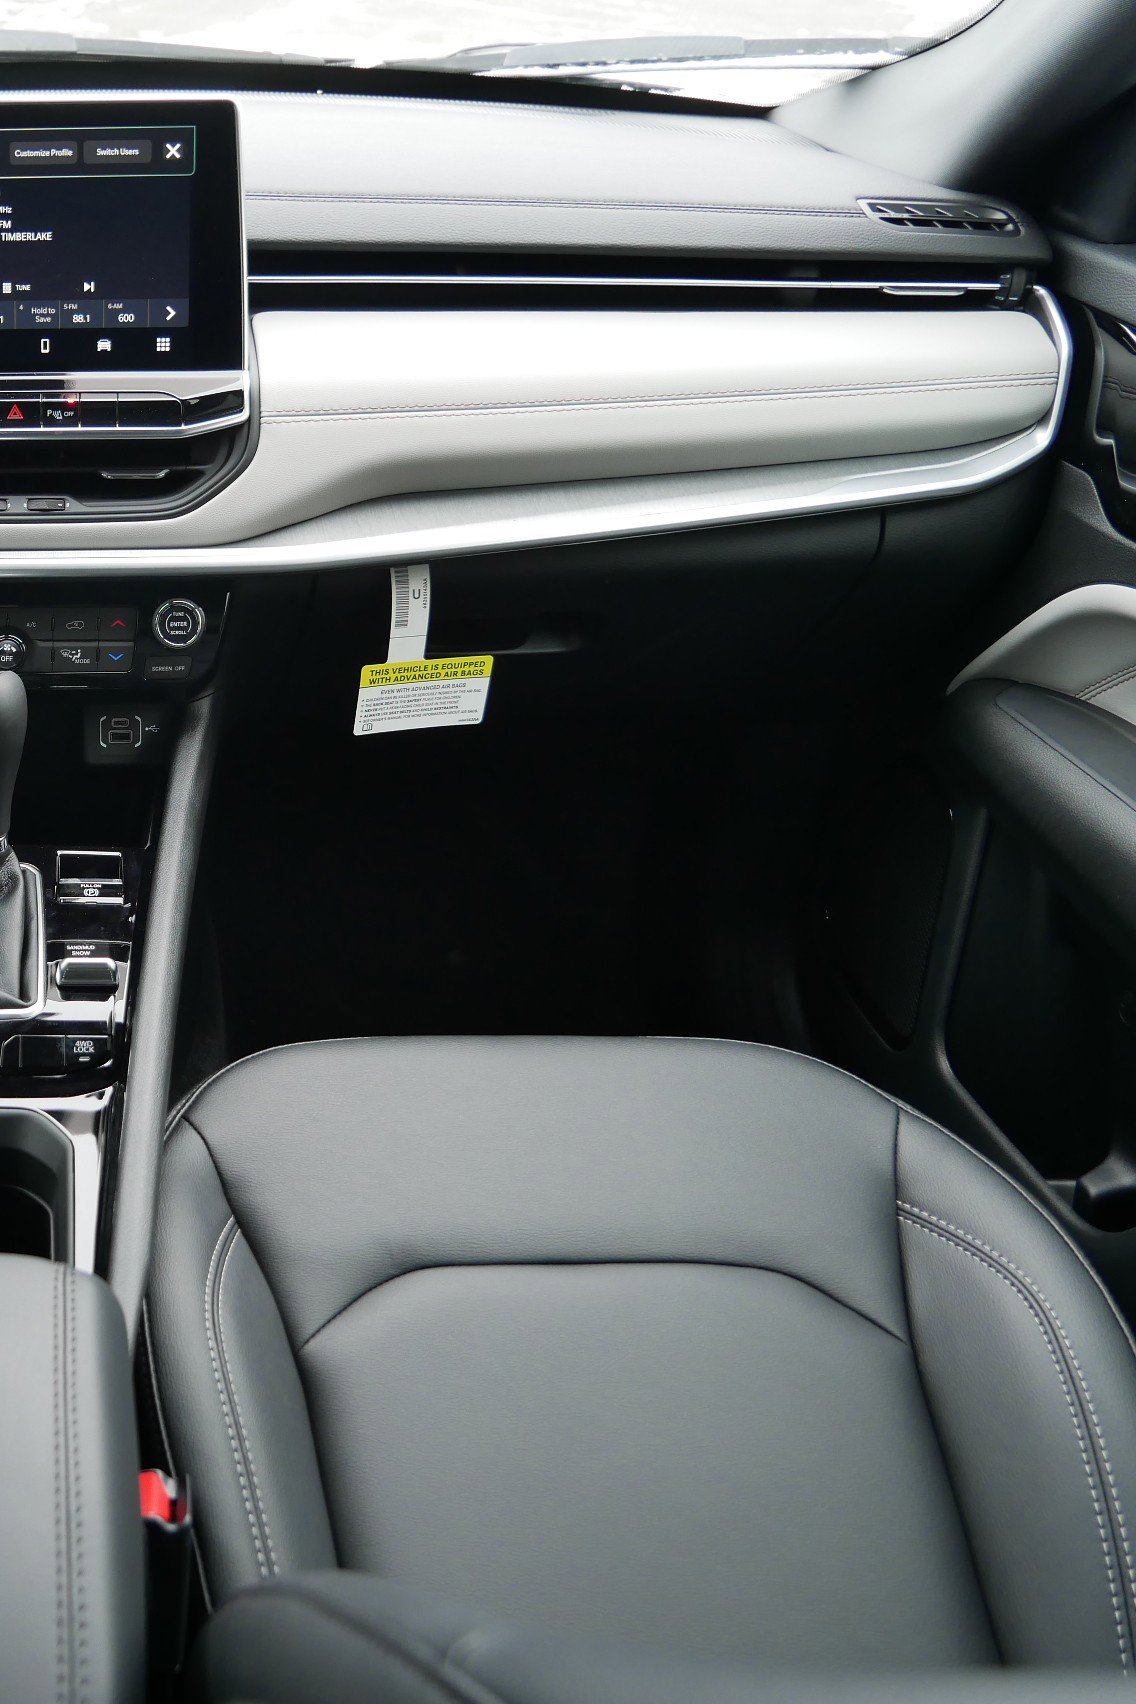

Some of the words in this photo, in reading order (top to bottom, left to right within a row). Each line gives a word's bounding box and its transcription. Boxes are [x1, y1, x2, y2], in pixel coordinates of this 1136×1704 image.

[14, 150, 50, 158] Customize
[51, 149, 73, 157] Profile
[96, 148, 119, 156] Switch
[120, 148, 140, 156] Users
[1, 231, 53, 241] TIMBERLAKE
[0, 316, 4, 324] 1
[35, 315, 51, 323] Save
[72, 315, 90, 323] 88.1
[118, 314, 135, 323] 600
[412, 589, 421, 600] U
[370, 668, 390, 677] THIS
[392, 664, 429, 675] VEHICLE
[441, 660, 486, 670] EQUIPPED
[368, 676, 391, 685] WITH
[393, 671, 442, 683] ADVANCED
[443, 669, 458, 678] AIR
[460, 668, 484, 677] BAGS
